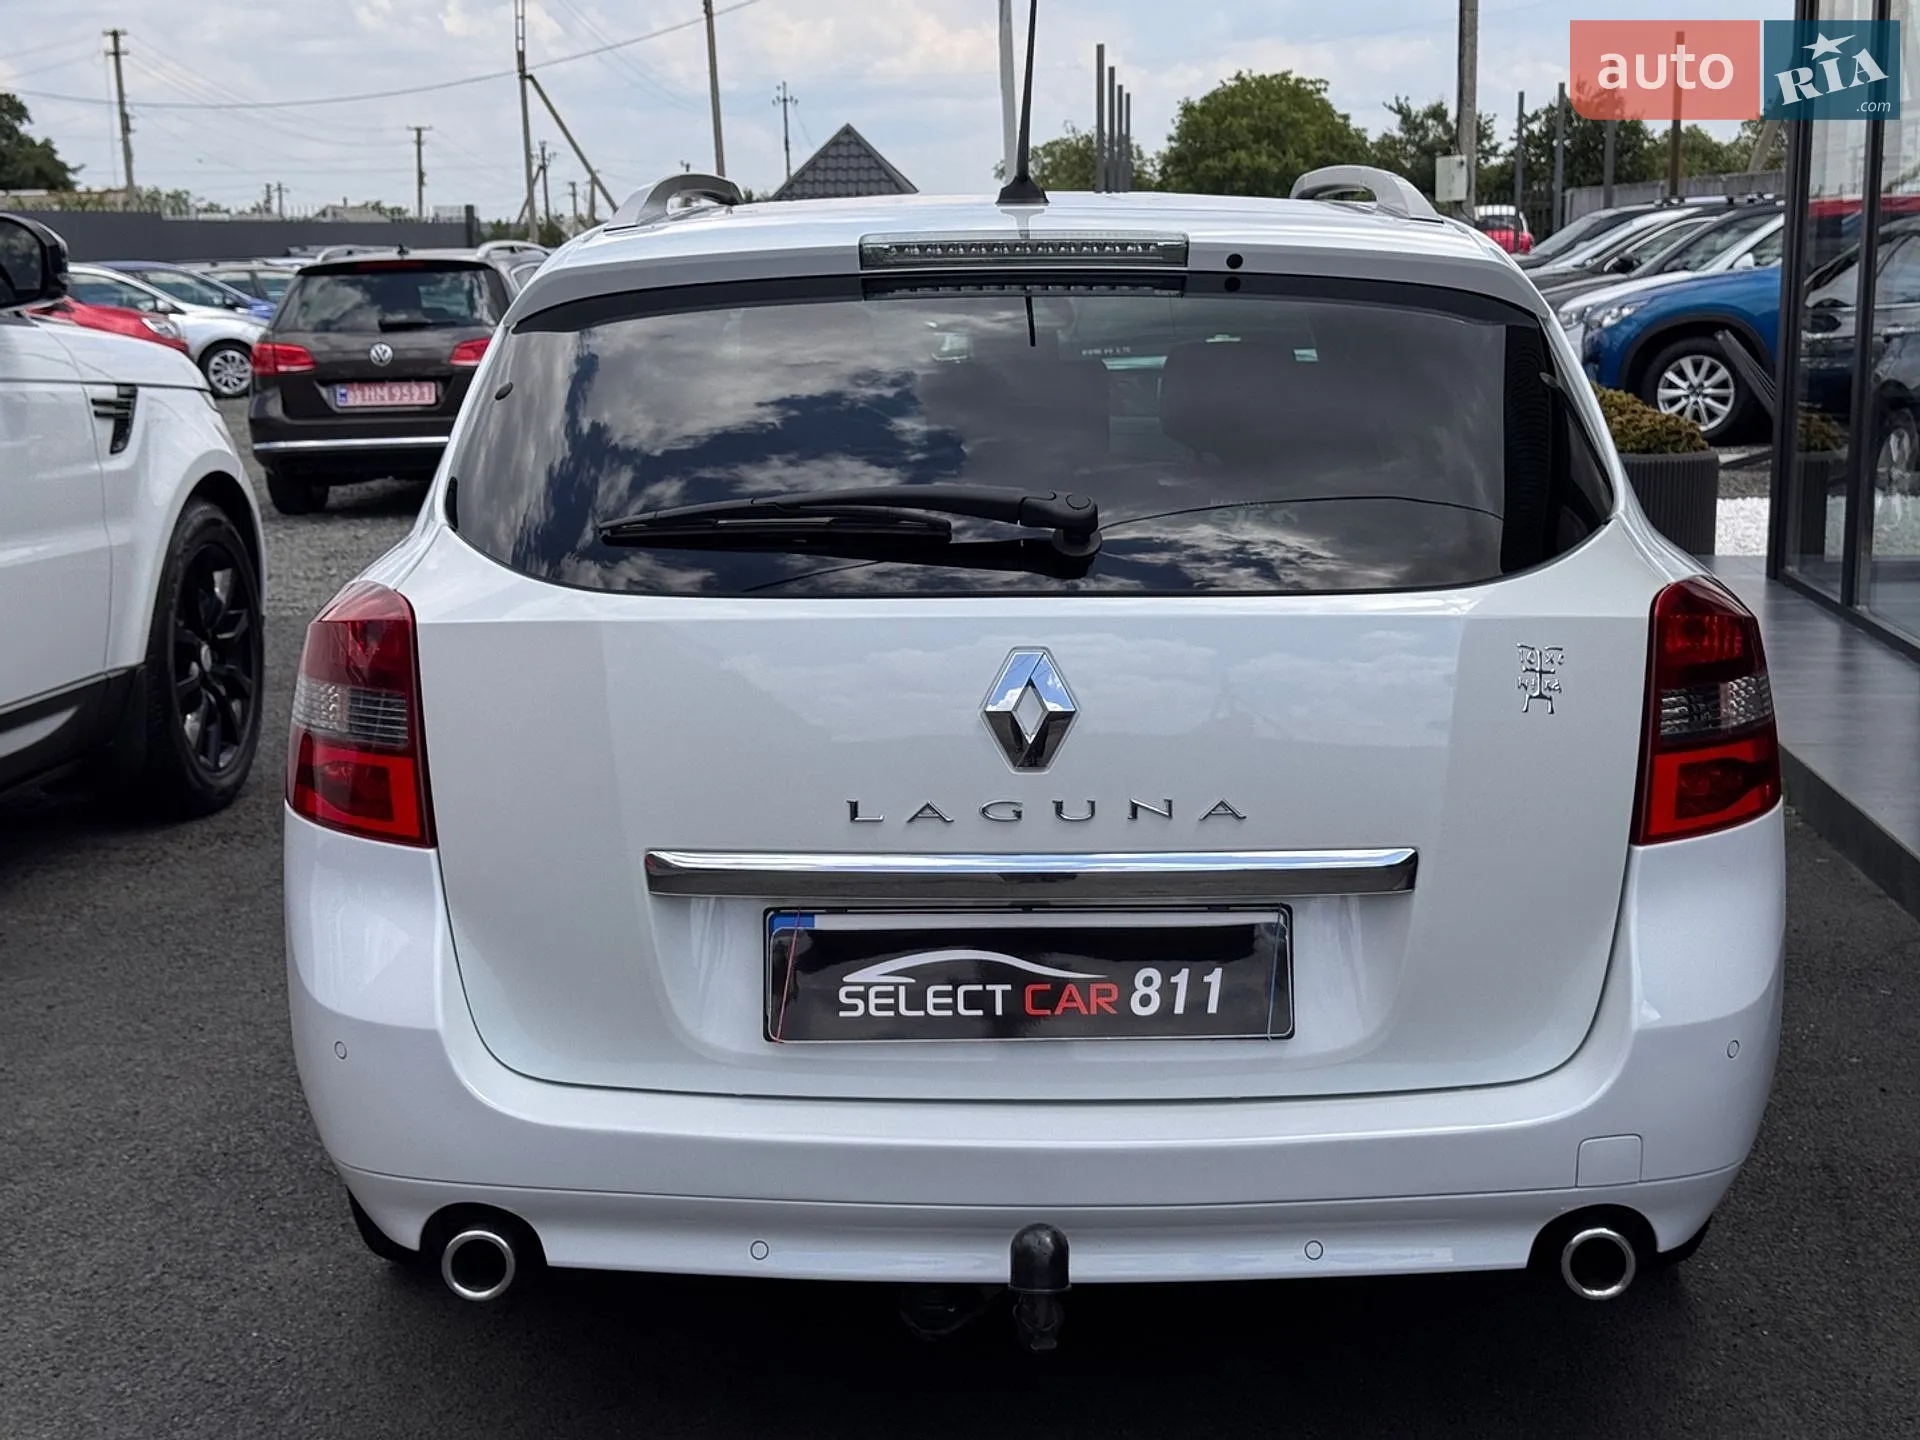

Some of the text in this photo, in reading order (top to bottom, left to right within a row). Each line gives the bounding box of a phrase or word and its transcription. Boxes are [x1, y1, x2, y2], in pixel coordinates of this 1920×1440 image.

[846, 799, 1248, 824] LAGUNA
[838, 967, 1224, 1017] SELECT CAR 811
